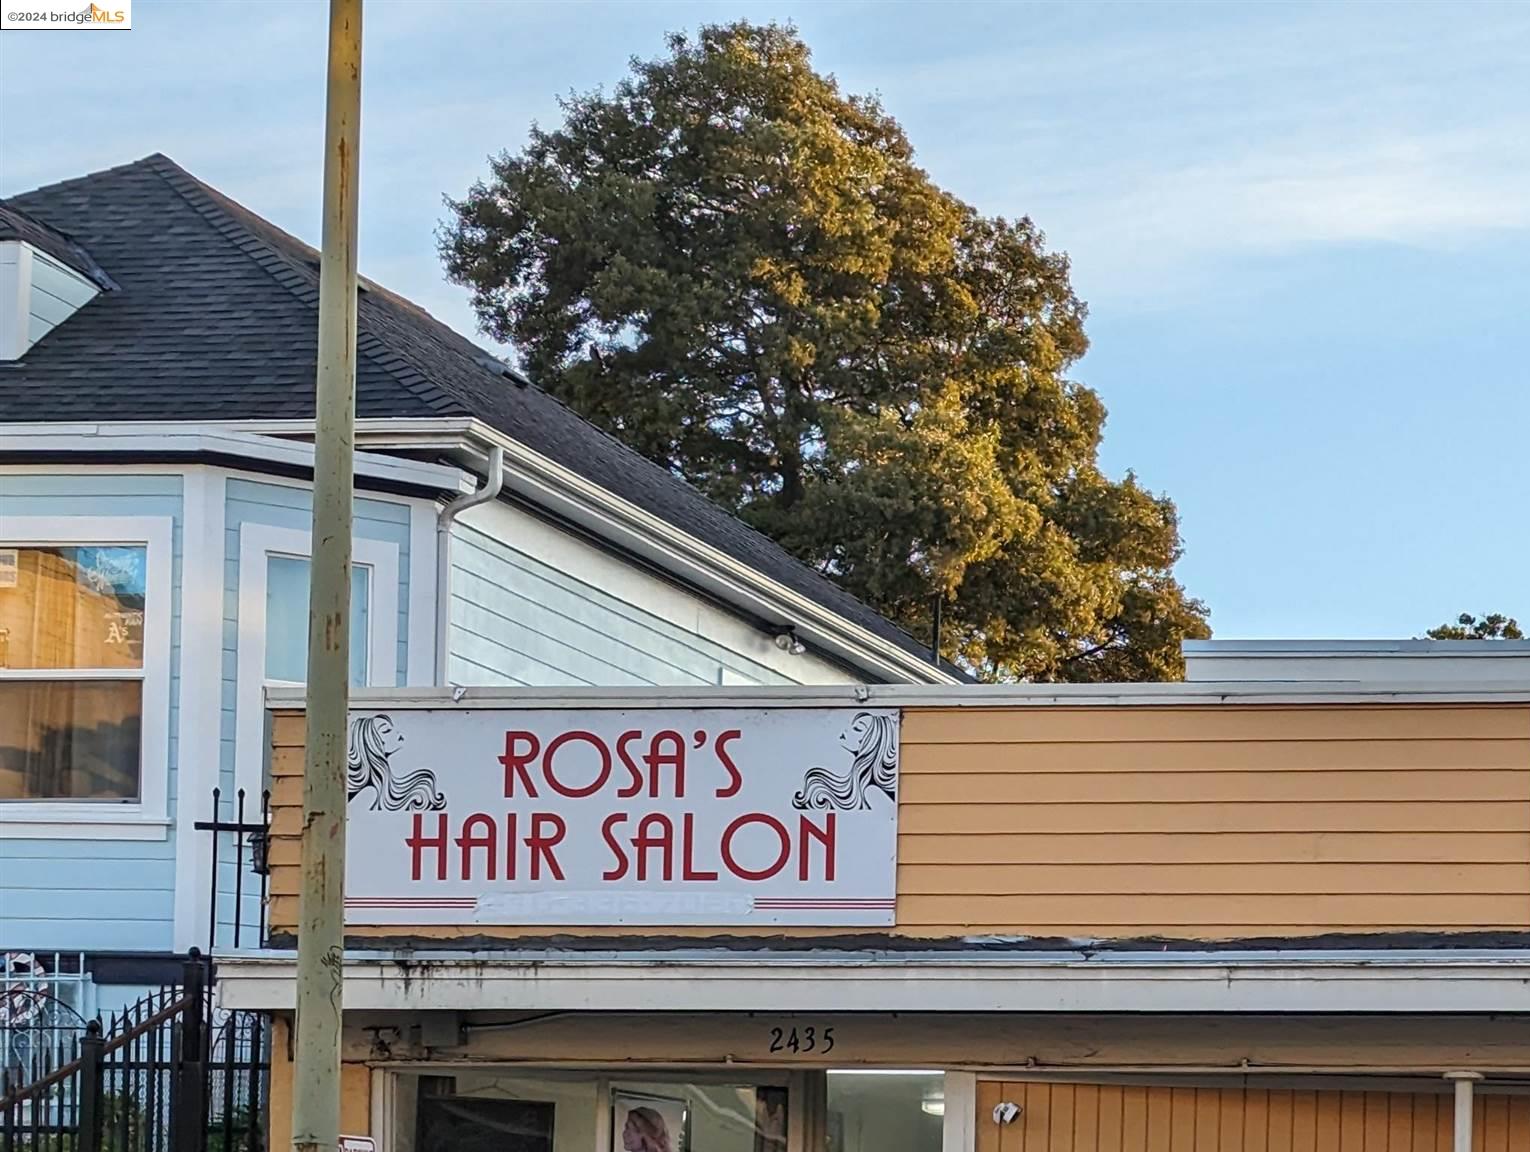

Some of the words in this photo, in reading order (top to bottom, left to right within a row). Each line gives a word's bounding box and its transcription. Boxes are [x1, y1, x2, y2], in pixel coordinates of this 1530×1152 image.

[497, 729, 742, 798] ROSA'S
[405, 812, 566, 882] HAIR
[601, 812, 836, 882] SALON
[769, 1026, 834, 1054] 2435
